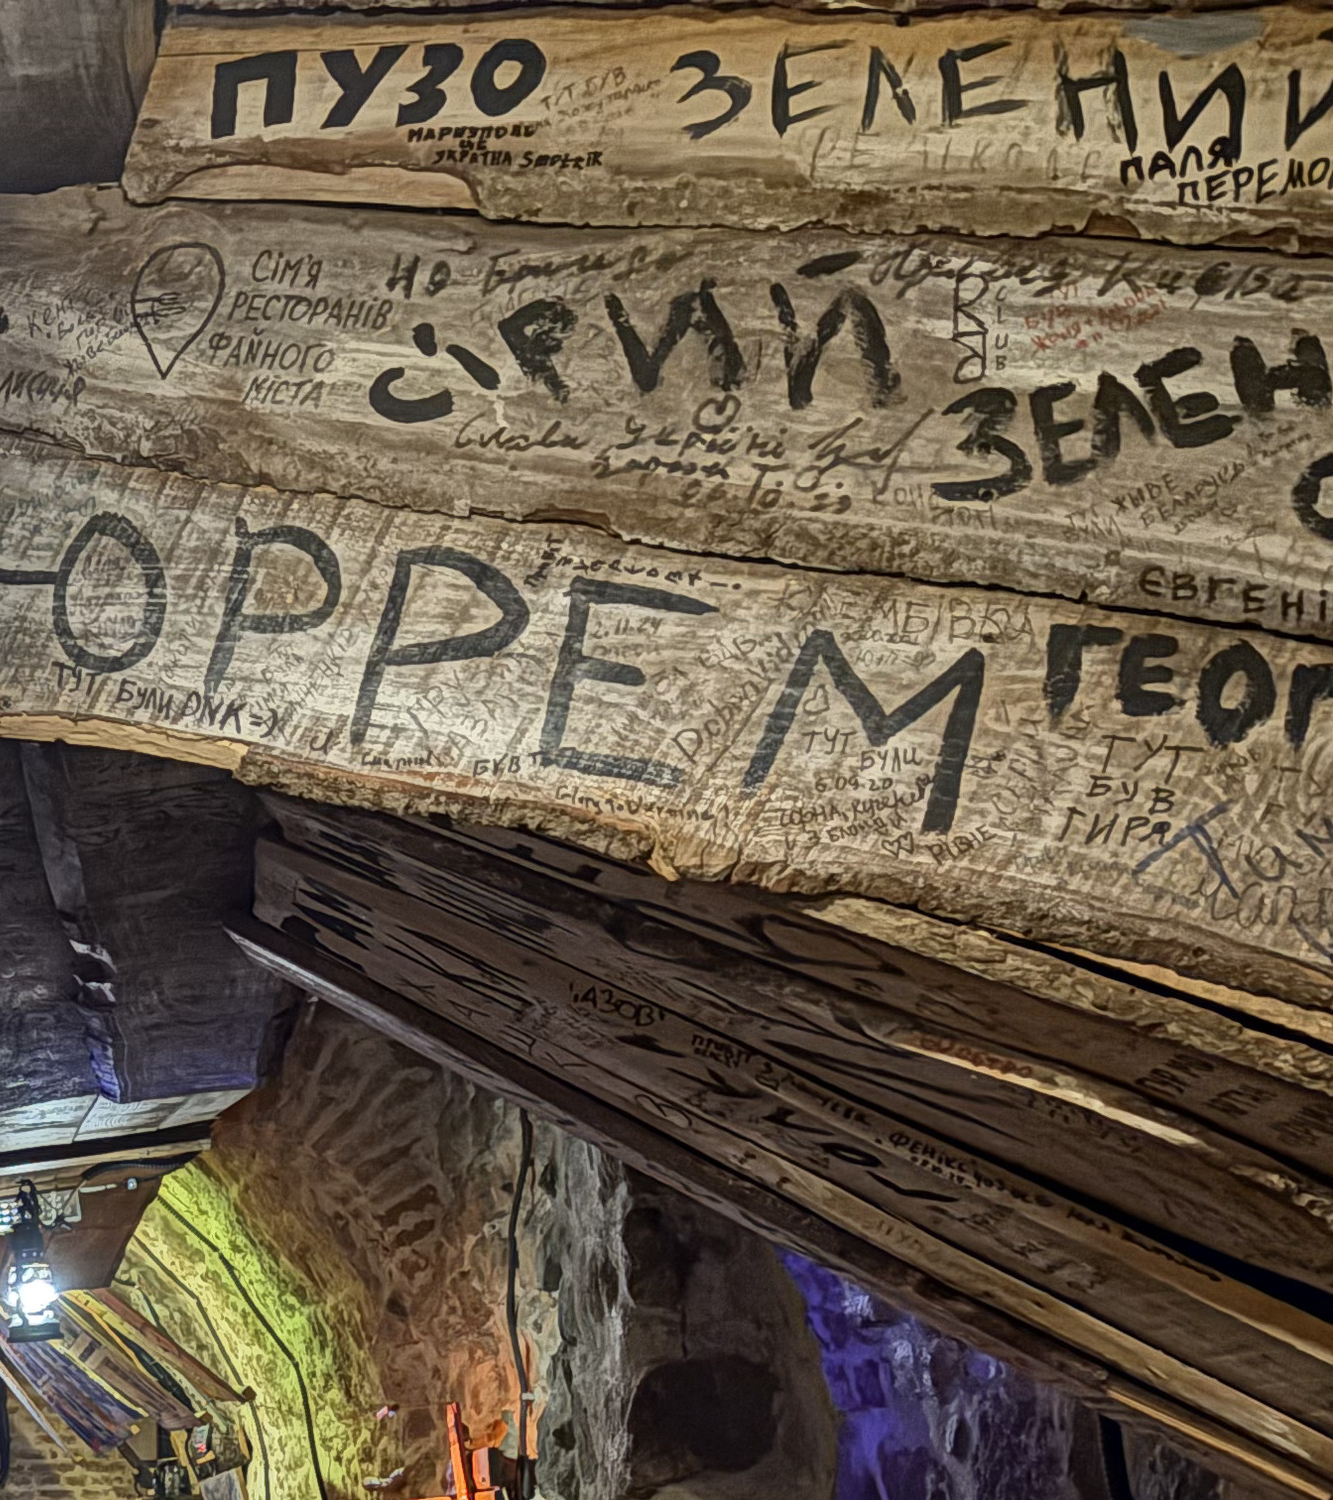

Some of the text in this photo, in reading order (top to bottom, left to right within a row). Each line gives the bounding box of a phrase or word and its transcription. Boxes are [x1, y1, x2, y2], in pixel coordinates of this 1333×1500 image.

[210, 37, 547, 140] ПУЗО
[1120, 137, 1239, 184] ПАЛЯ
[250, 249, 324, 291] СІМ'Я
[232, 292, 394, 331] РЕСТОРАНІВ
[207, 328, 335, 375] ФАЙНОГО
[241, 377, 329, 408] МІСТА
[51, 662, 100, 697] ТУТ
[117, 680, 173, 720] БУЛИ
[802, 728, 857, 754] ТУТ
[859, 746, 923, 773] БУЛИ
[1101, 733, 1205, 785] ТУТ
[1086, 775, 1175, 815] БУВ
[1057, 807, 1172, 847] ГИРЯ
